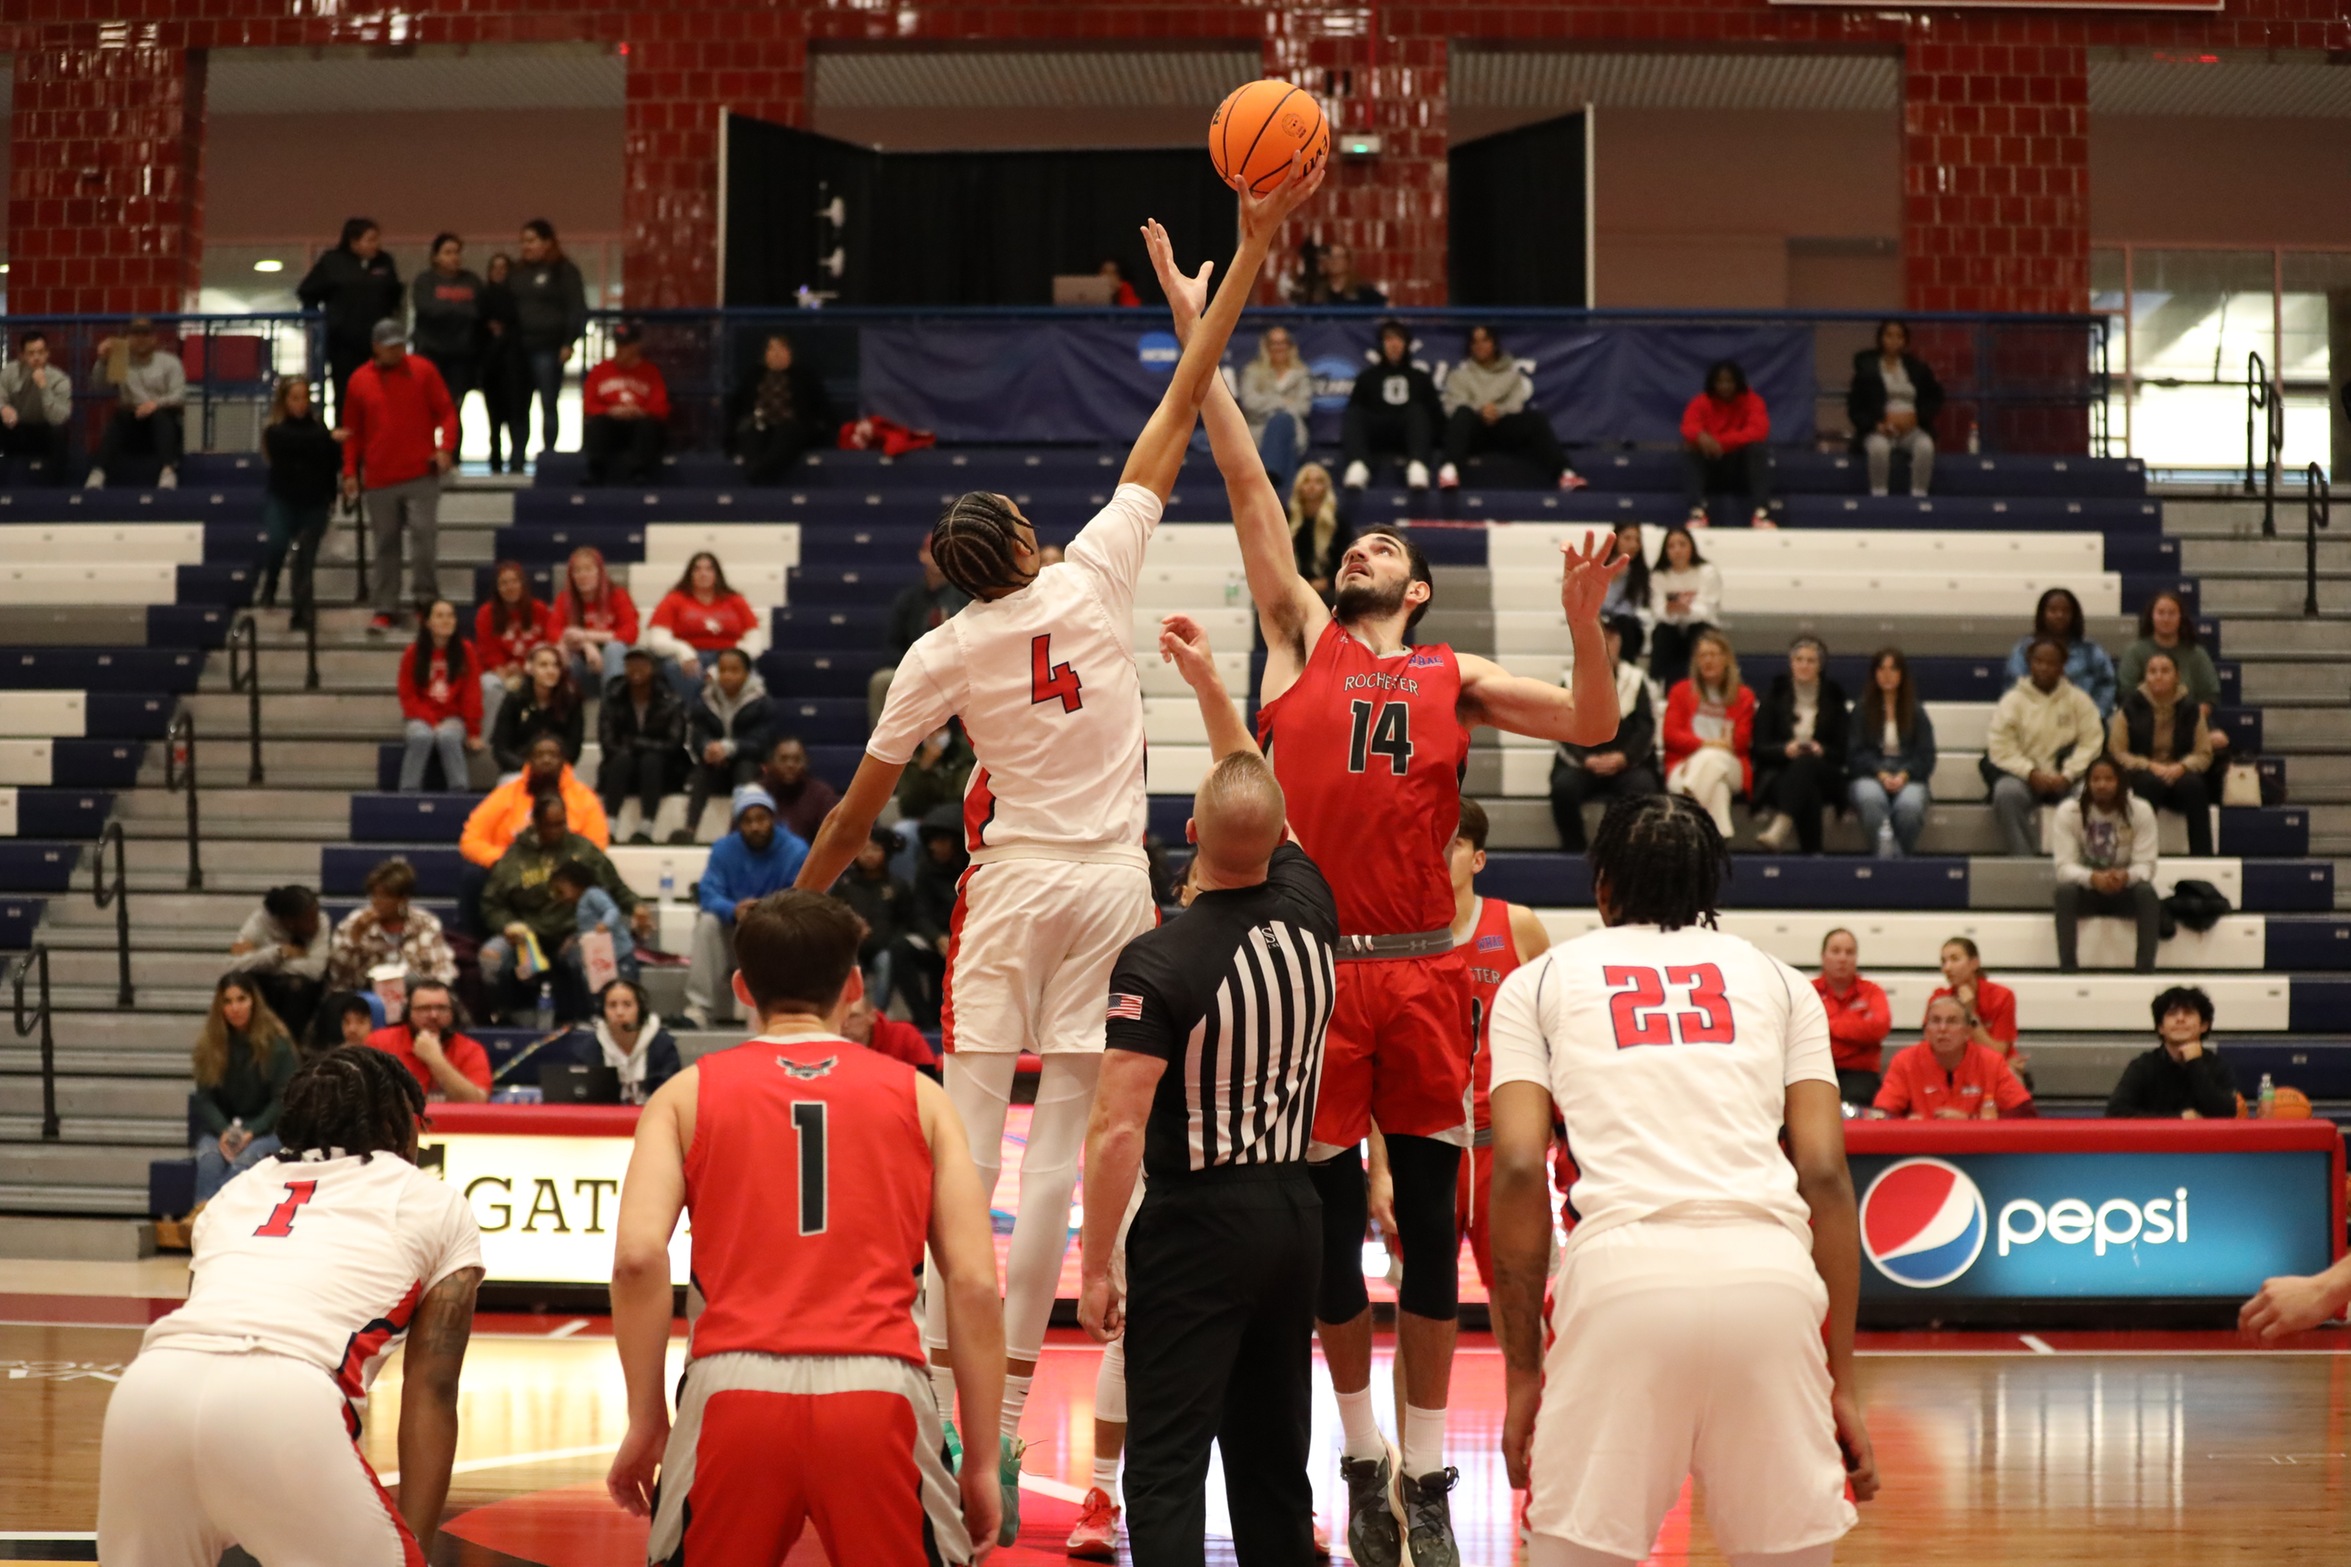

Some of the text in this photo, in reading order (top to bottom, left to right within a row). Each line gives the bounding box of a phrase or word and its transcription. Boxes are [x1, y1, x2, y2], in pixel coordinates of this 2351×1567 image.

[1031, 632, 1083, 714] 4
[1348, 698, 1414, 776] 14
[1602, 962, 1736, 1051] 23
[790, 1100, 828, 1236] 1
[252, 1179, 318, 1238] 1
[1998, 1186, 2188, 1257] pepsi
